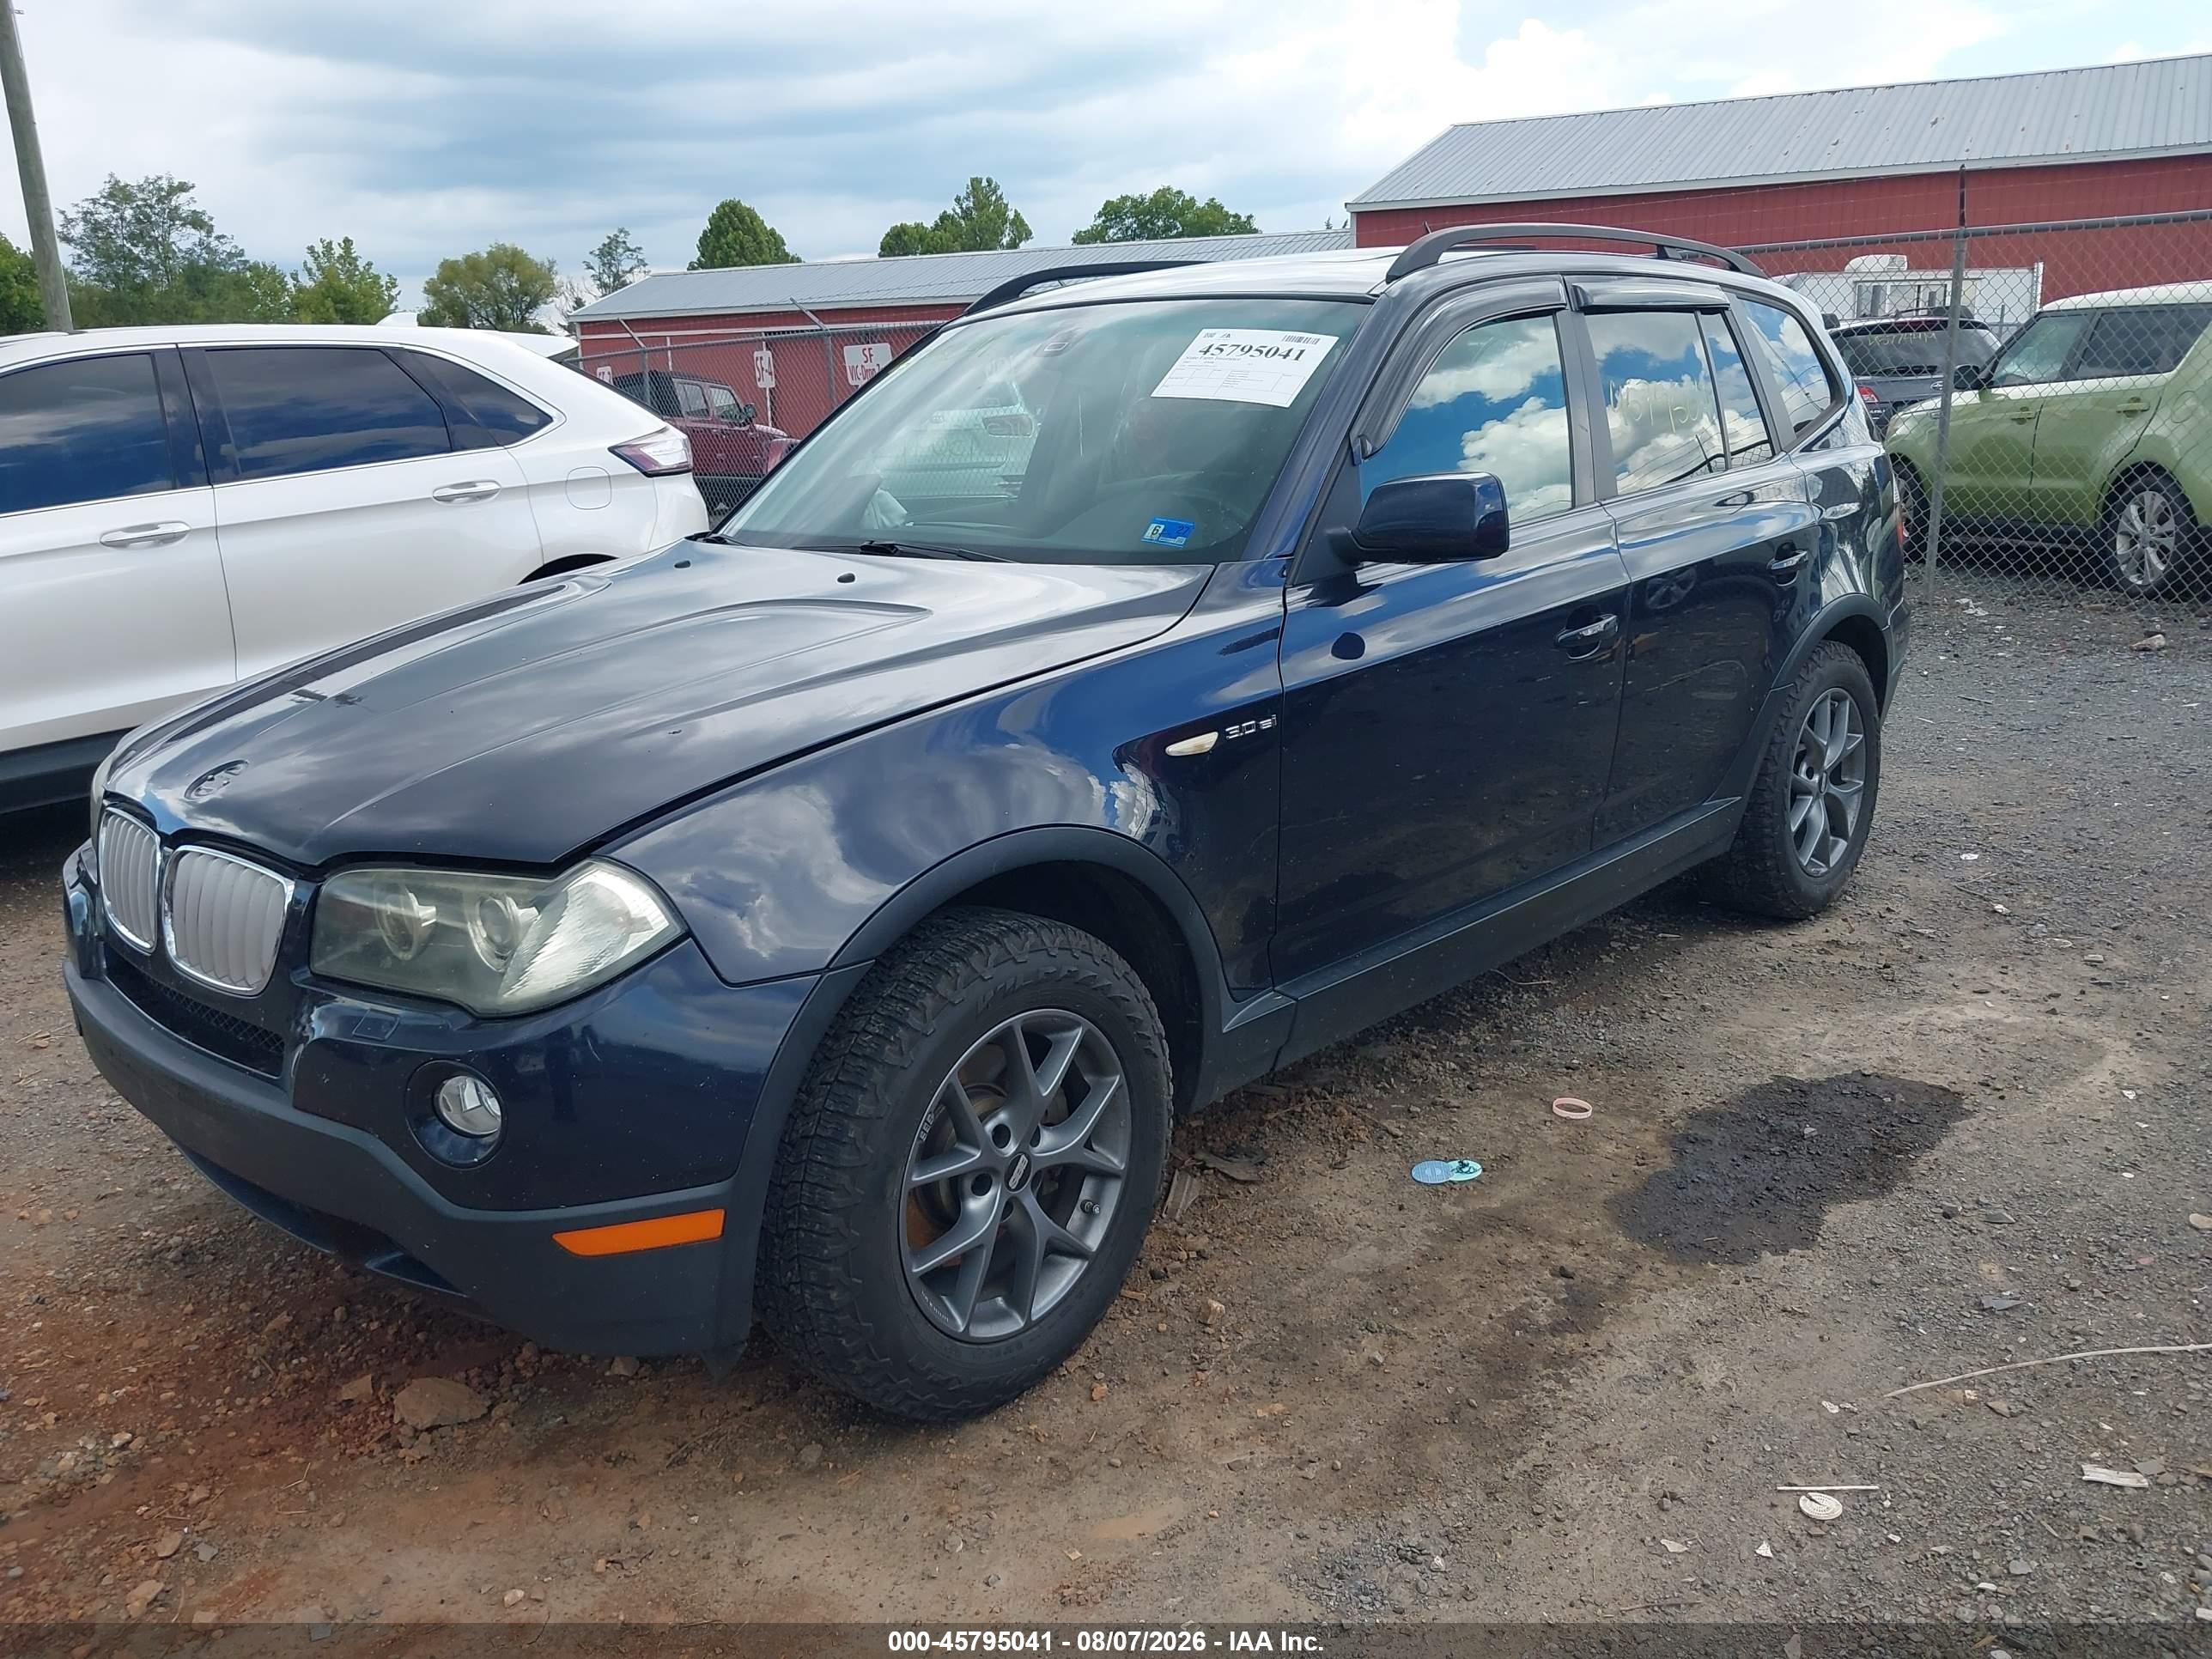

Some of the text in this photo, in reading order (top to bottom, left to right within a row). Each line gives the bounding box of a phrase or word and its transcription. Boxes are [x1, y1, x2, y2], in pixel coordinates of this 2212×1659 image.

[861, 347, 874, 364] SF
[1199, 343, 1307, 362] 45795041
[755, 356, 775, 383] SF-4
[1152, 526, 1161, 536] 6
[1008, 1153, 1029, 1189] BBS
